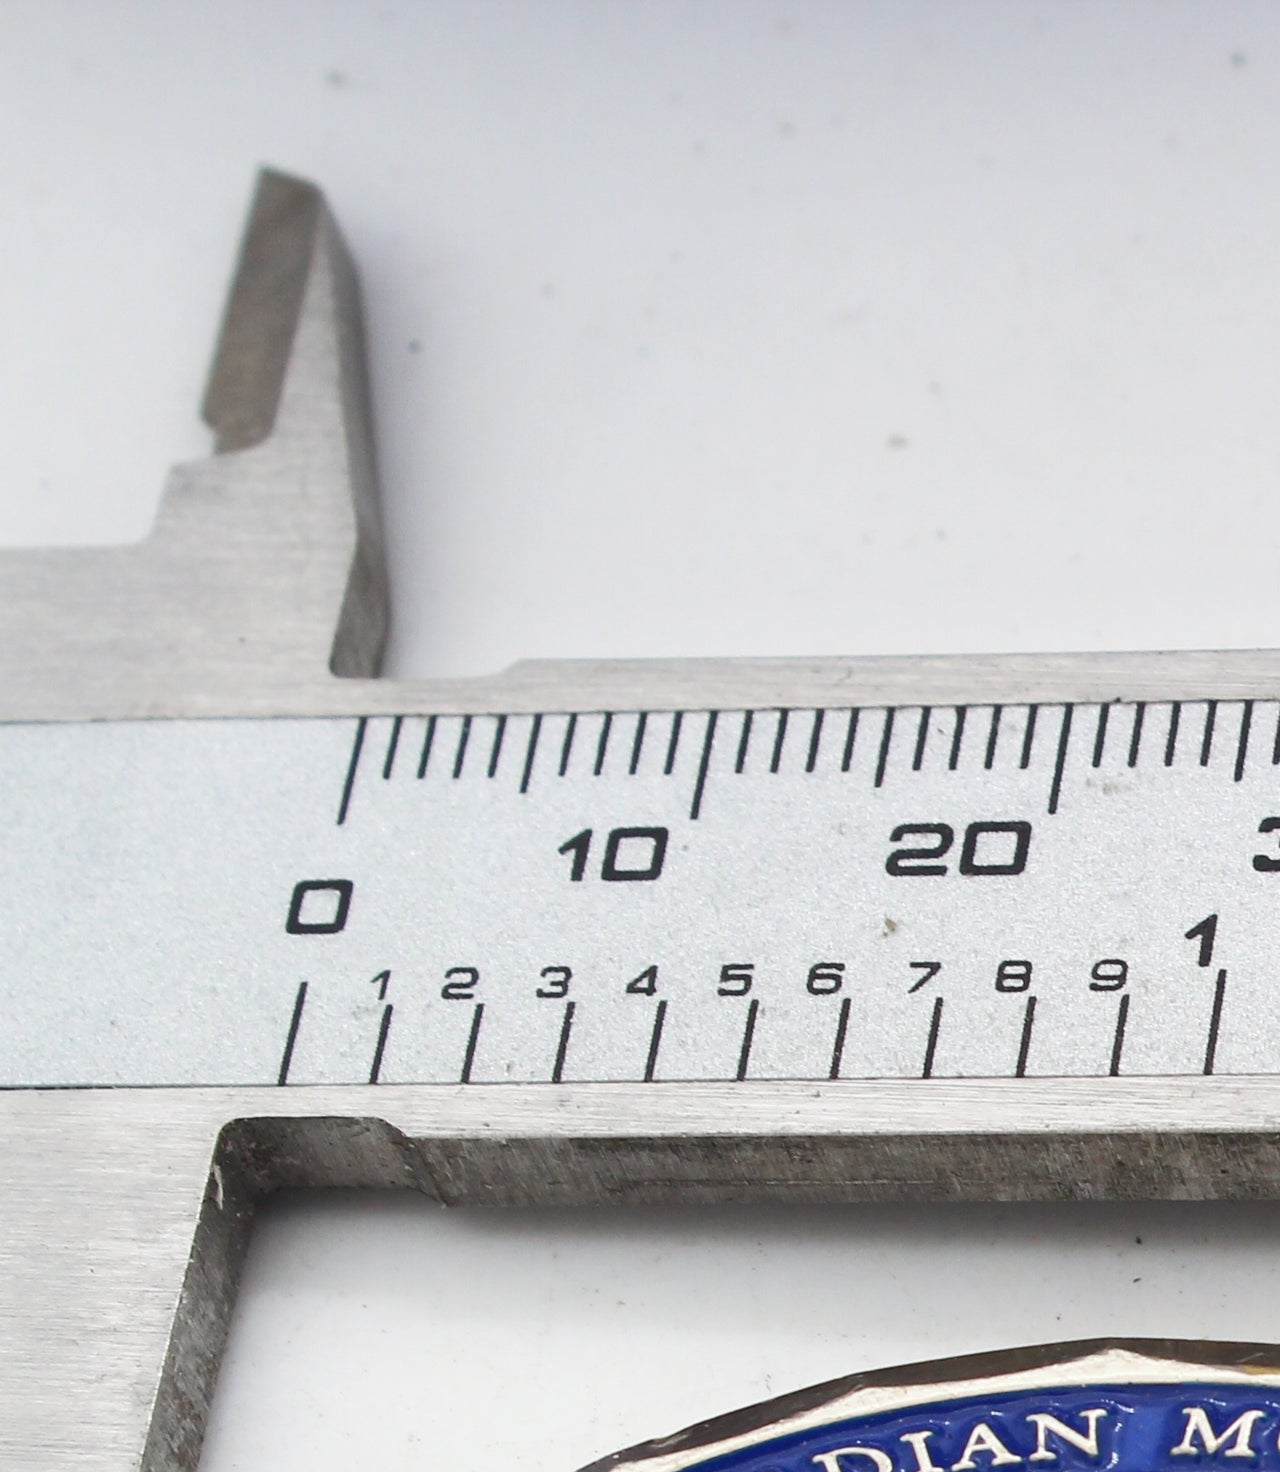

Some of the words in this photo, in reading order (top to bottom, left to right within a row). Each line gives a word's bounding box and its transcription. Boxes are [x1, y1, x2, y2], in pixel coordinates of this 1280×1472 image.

[286, 880, 353, 934] 0
[559, 827, 668, 881] 10
[886, 821, 1032, 876] 20
[370, 970, 391, 1001] 1
[441, 967, 479, 1000] 2
[536, 966, 572, 999] 3
[625, 965, 658, 997] 4
[718, 963, 754, 996] 5
[806, 962, 846, 996] 6
[908, 961, 942, 994] 7
[995, 959, 1033, 993] 8
[1088, 958, 1129, 992] 9
[1184, 913, 1218, 968] 1
